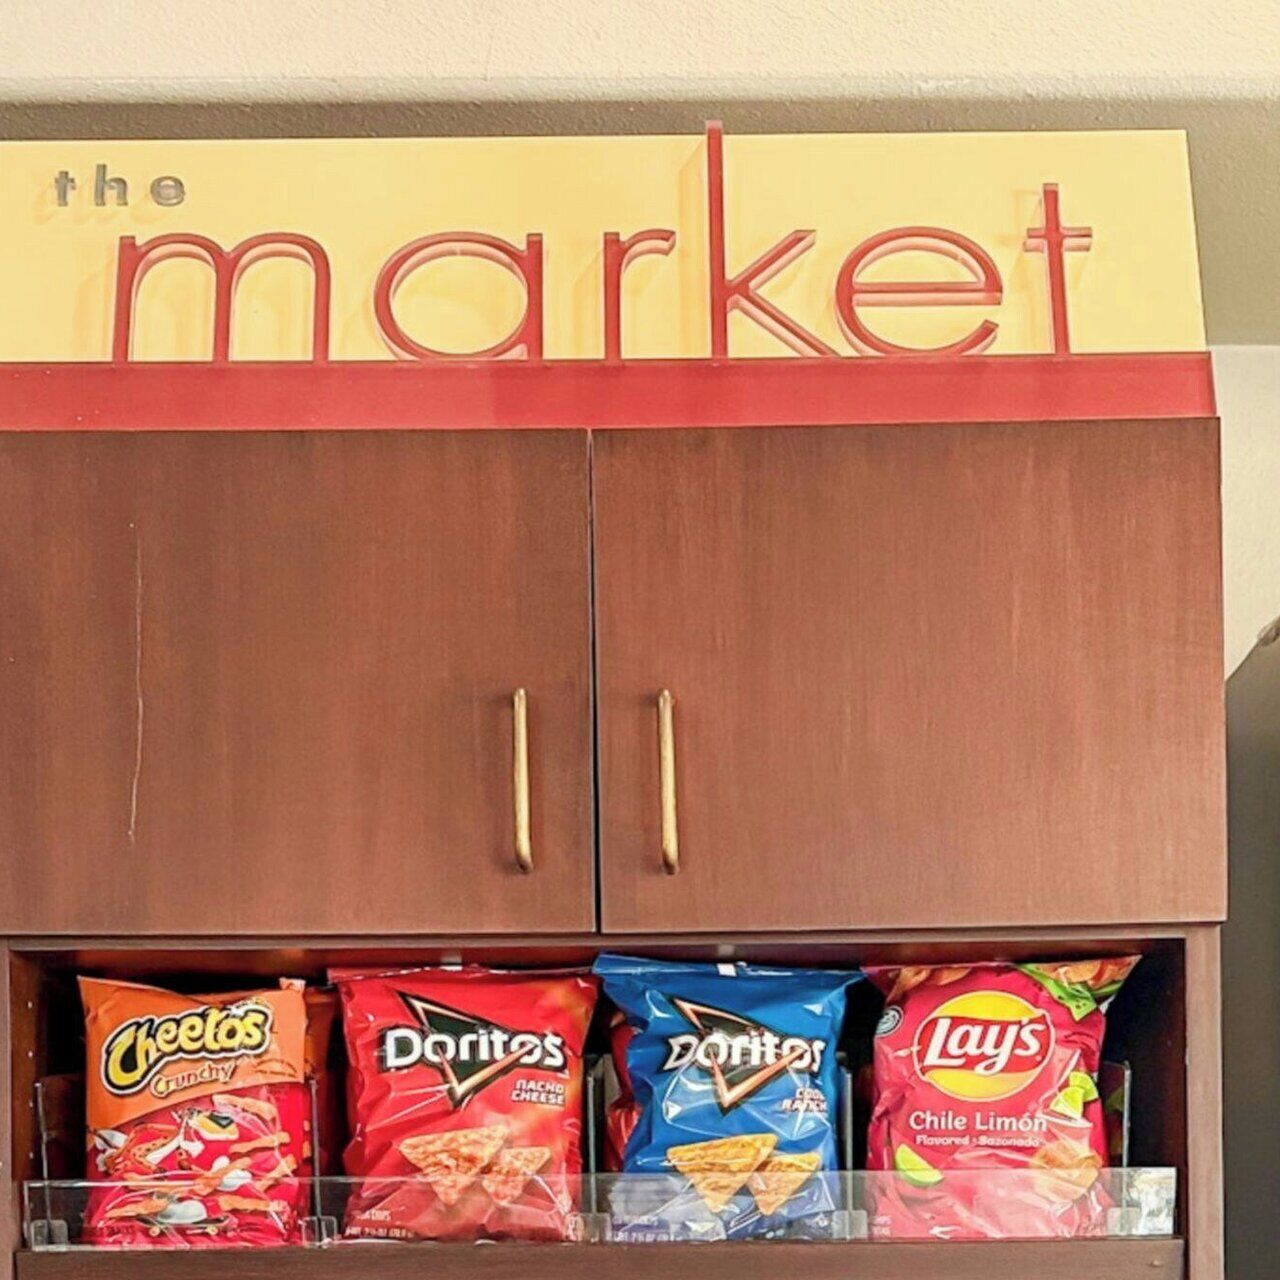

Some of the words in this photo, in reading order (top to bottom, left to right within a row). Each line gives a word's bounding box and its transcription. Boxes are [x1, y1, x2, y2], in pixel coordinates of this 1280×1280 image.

[53, 162, 187, 208] the
[112, 120, 1094, 364] market
[104, 1006, 271, 1092] Cheetos
[383, 1026, 566, 1069] Doritos
[663, 1031, 827, 1073] Doritos
[923, 1016, 1047, 1076] Lay's
[151, 1061, 236, 1098] Crunchy
[510, 1090, 565, 1106] CHEESE
[516, 1079, 565, 1093] NACHO
[909, 1111, 968, 1131] Chile
[975, 1110, 1048, 1132] Limón
[915, 1134, 970, 1147] Flavored
